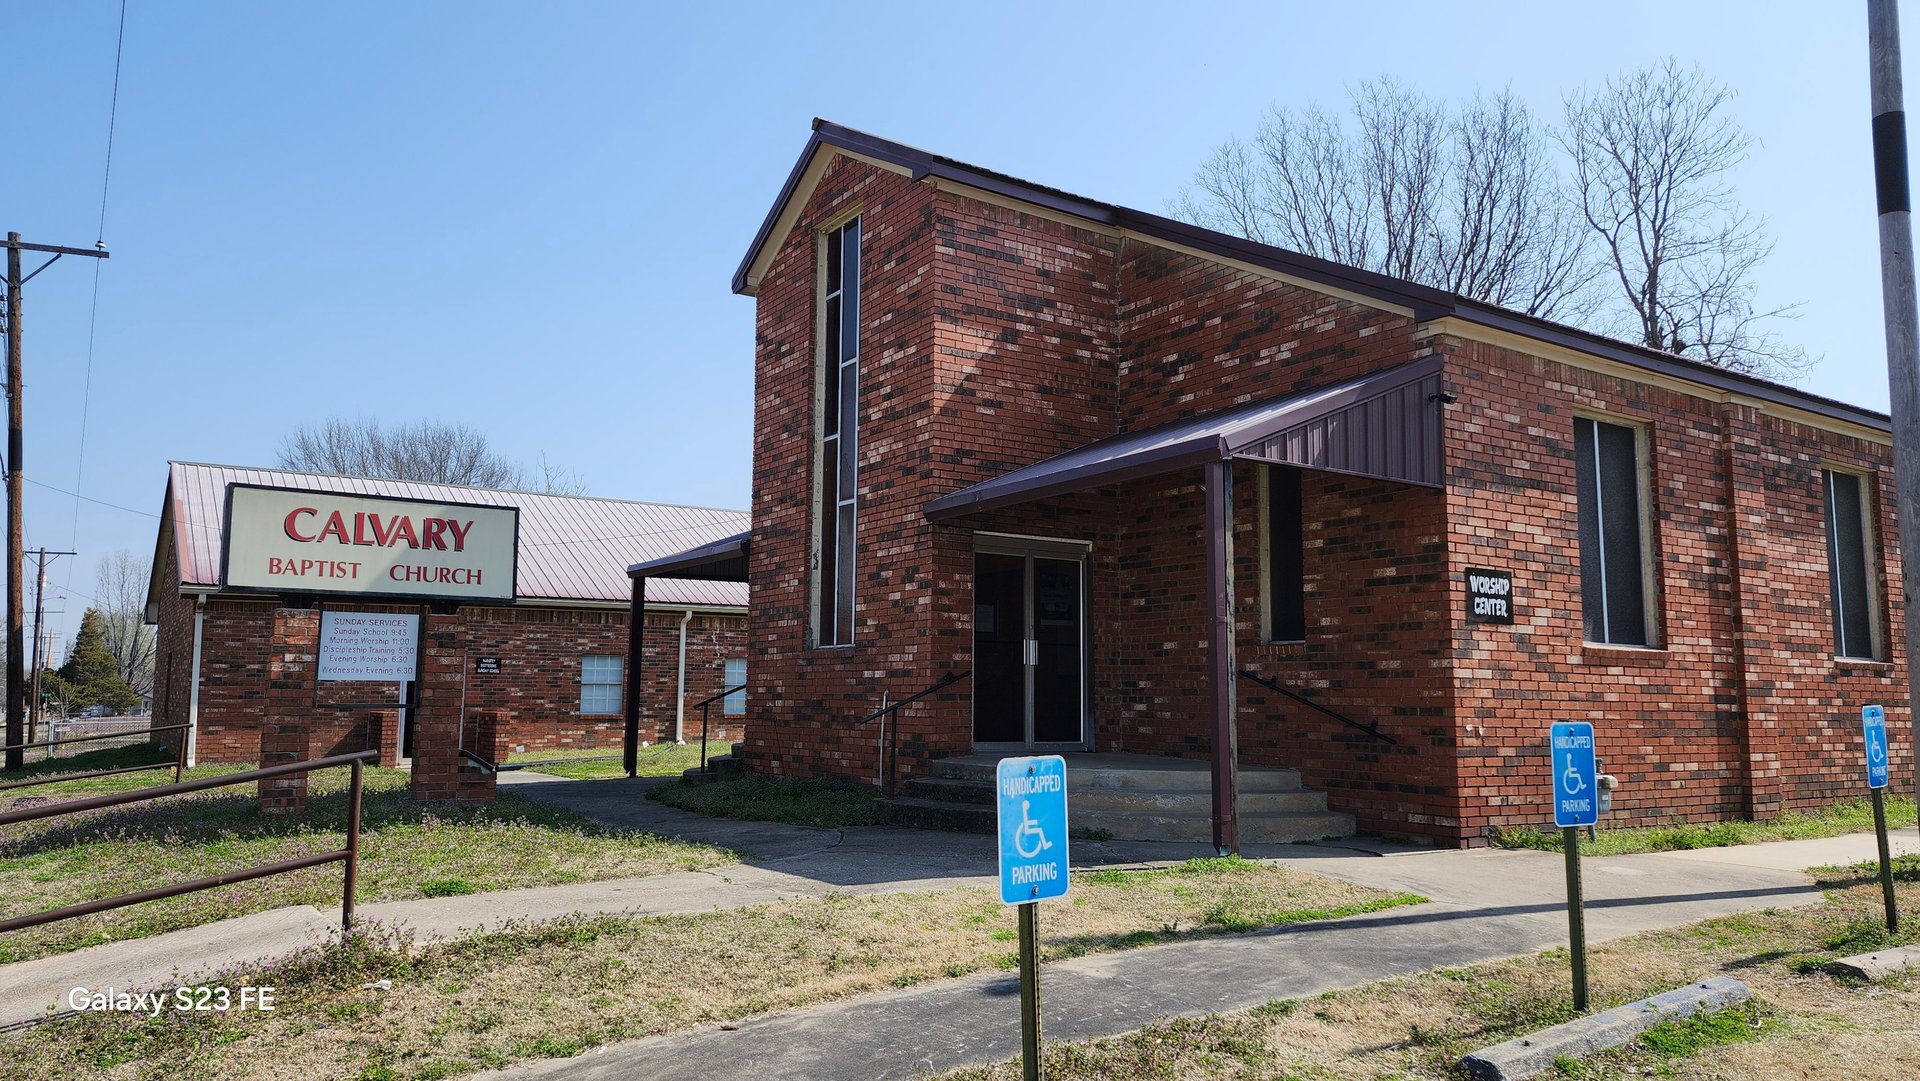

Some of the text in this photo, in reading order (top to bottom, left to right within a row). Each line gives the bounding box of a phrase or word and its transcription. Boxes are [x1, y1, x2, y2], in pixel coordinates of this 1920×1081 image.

[284, 507, 474, 552] CALVARY
[268, 557, 482, 585] BAPTIST CHURCH
[1470, 575, 1510, 595] WORSHIP
[1474, 597, 1508, 617] CENTER
[333, 627, 360, 636] Sunday
[363, 628, 388, 636] School
[329, 637, 358, 645] Morning
[323, 646, 367, 654] Discipleship
[369, 647, 395, 655] Training
[329, 655, 357, 663] Evening
[322, 666, 363, 674] Wednesday
[366, 667, 394, 675] Evening
[1554, 736, 1591, 749] HANDICAPPED
[1003, 774, 1061, 797] HANDICAPPED
[1561, 799, 1591, 813] PARKING
[1012, 862, 1057, 885] PARKING
